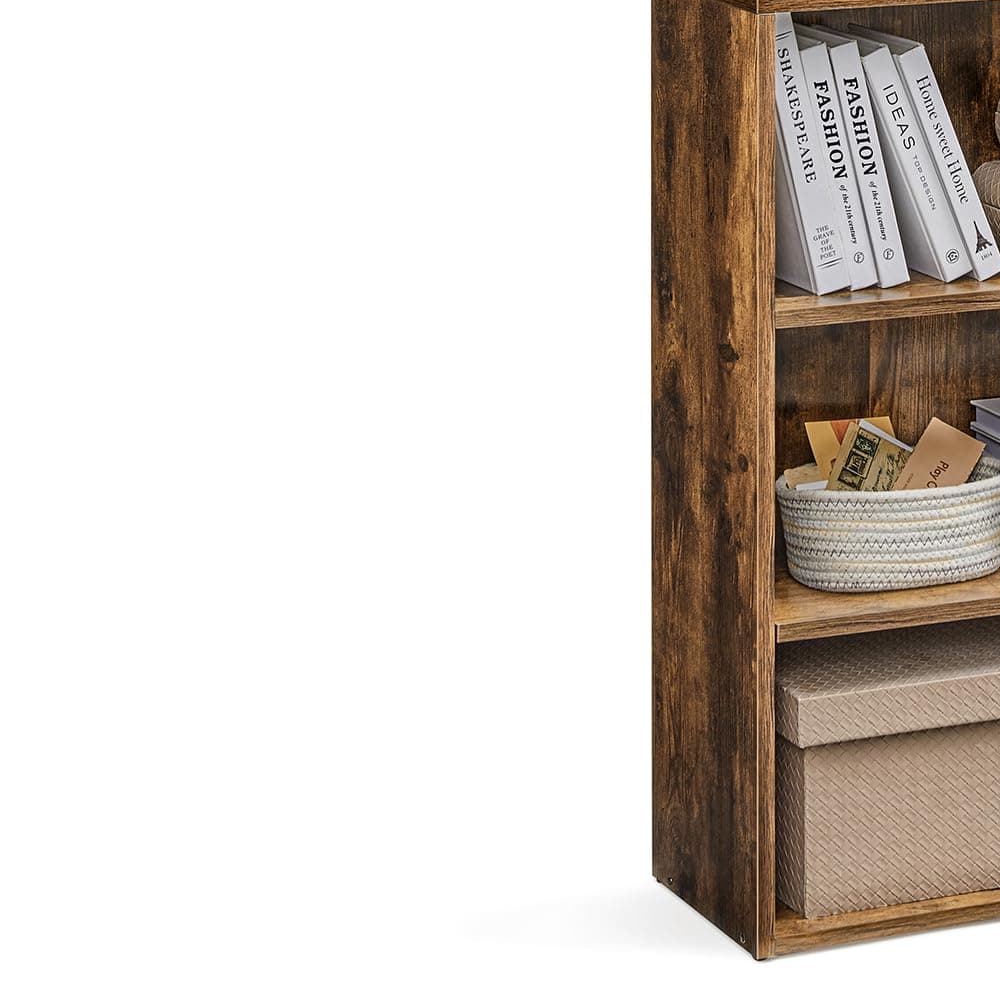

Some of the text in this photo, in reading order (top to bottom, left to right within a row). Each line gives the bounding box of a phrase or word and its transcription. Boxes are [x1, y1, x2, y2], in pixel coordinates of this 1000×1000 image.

[778, 48, 817, 184] SHAKESPEARE
[814, 80, 848, 179] FASHION
[843, 76, 878, 176] FASHION
[883, 84, 916, 150] IDEAS
[916, 75, 969, 204] Home sweet Home
[930, 460, 950, 480] Play
